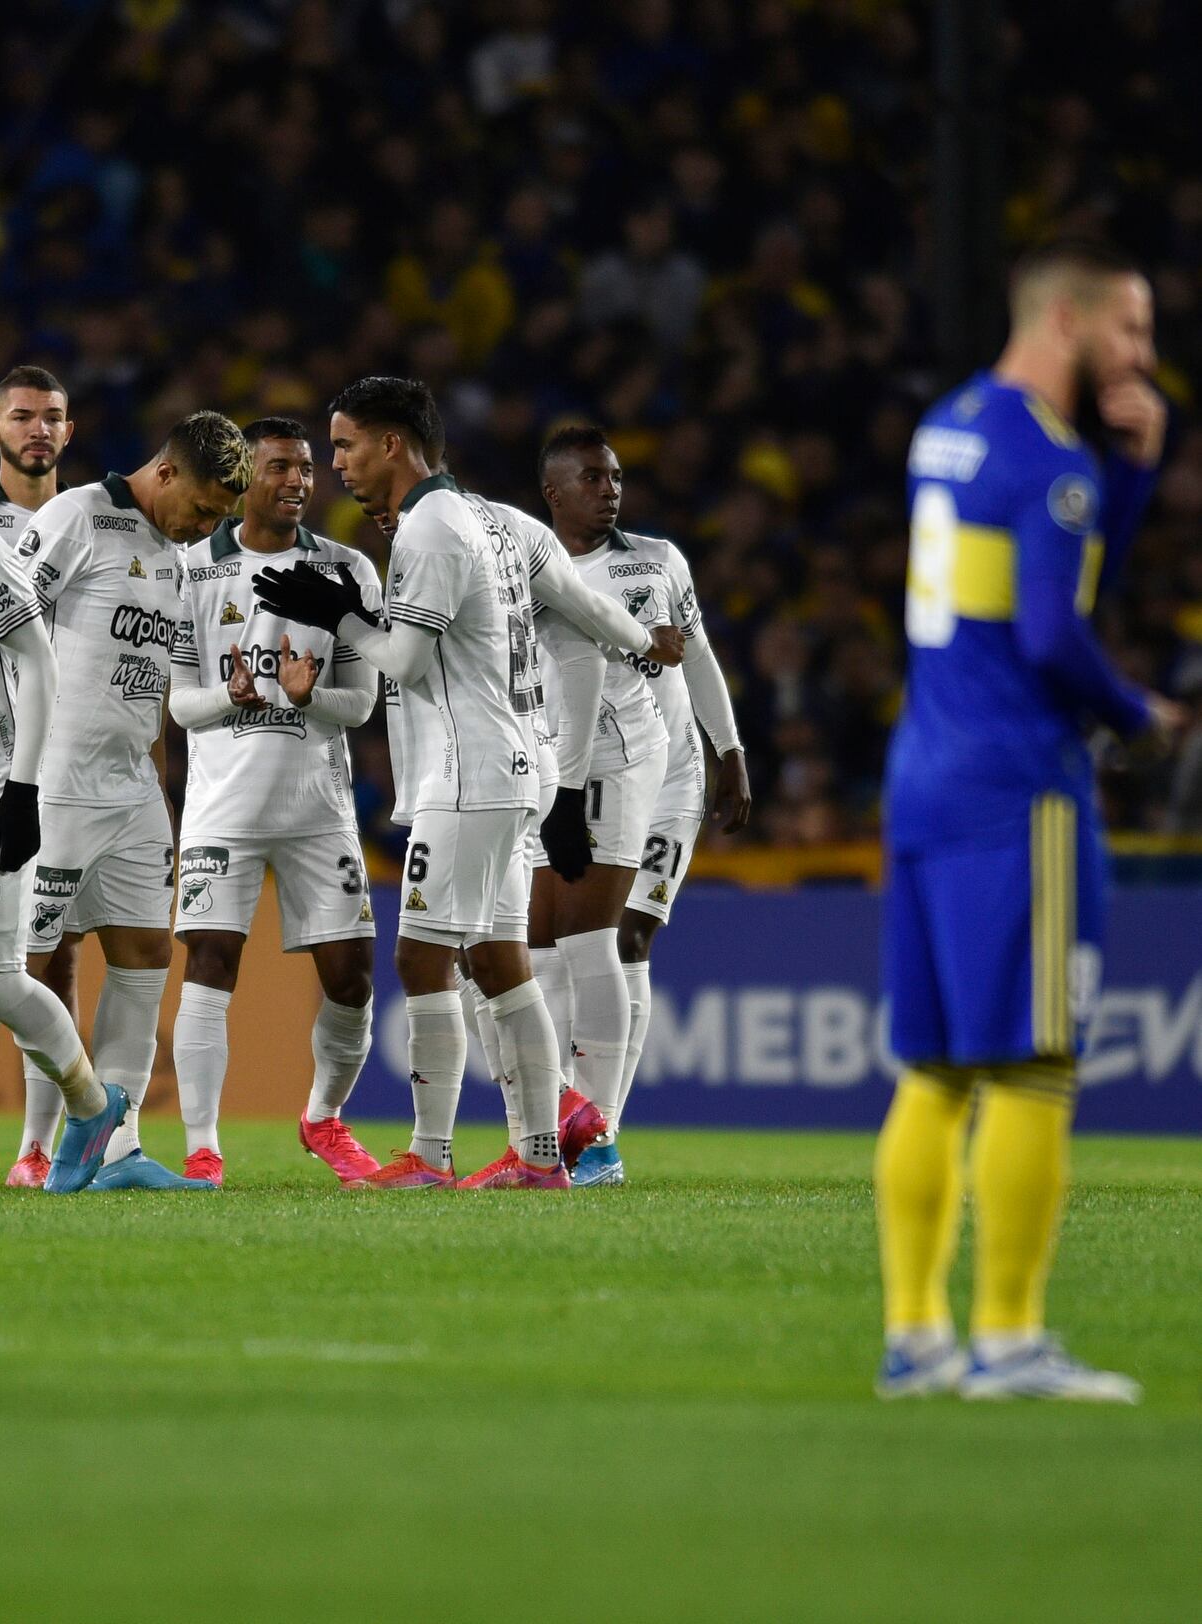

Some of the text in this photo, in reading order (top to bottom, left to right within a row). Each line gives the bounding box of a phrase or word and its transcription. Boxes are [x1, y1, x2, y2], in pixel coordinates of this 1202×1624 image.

[407, 841, 430, 884] 6
[642, 835, 683, 879] 21
[35, 876, 80, 896] hunky
